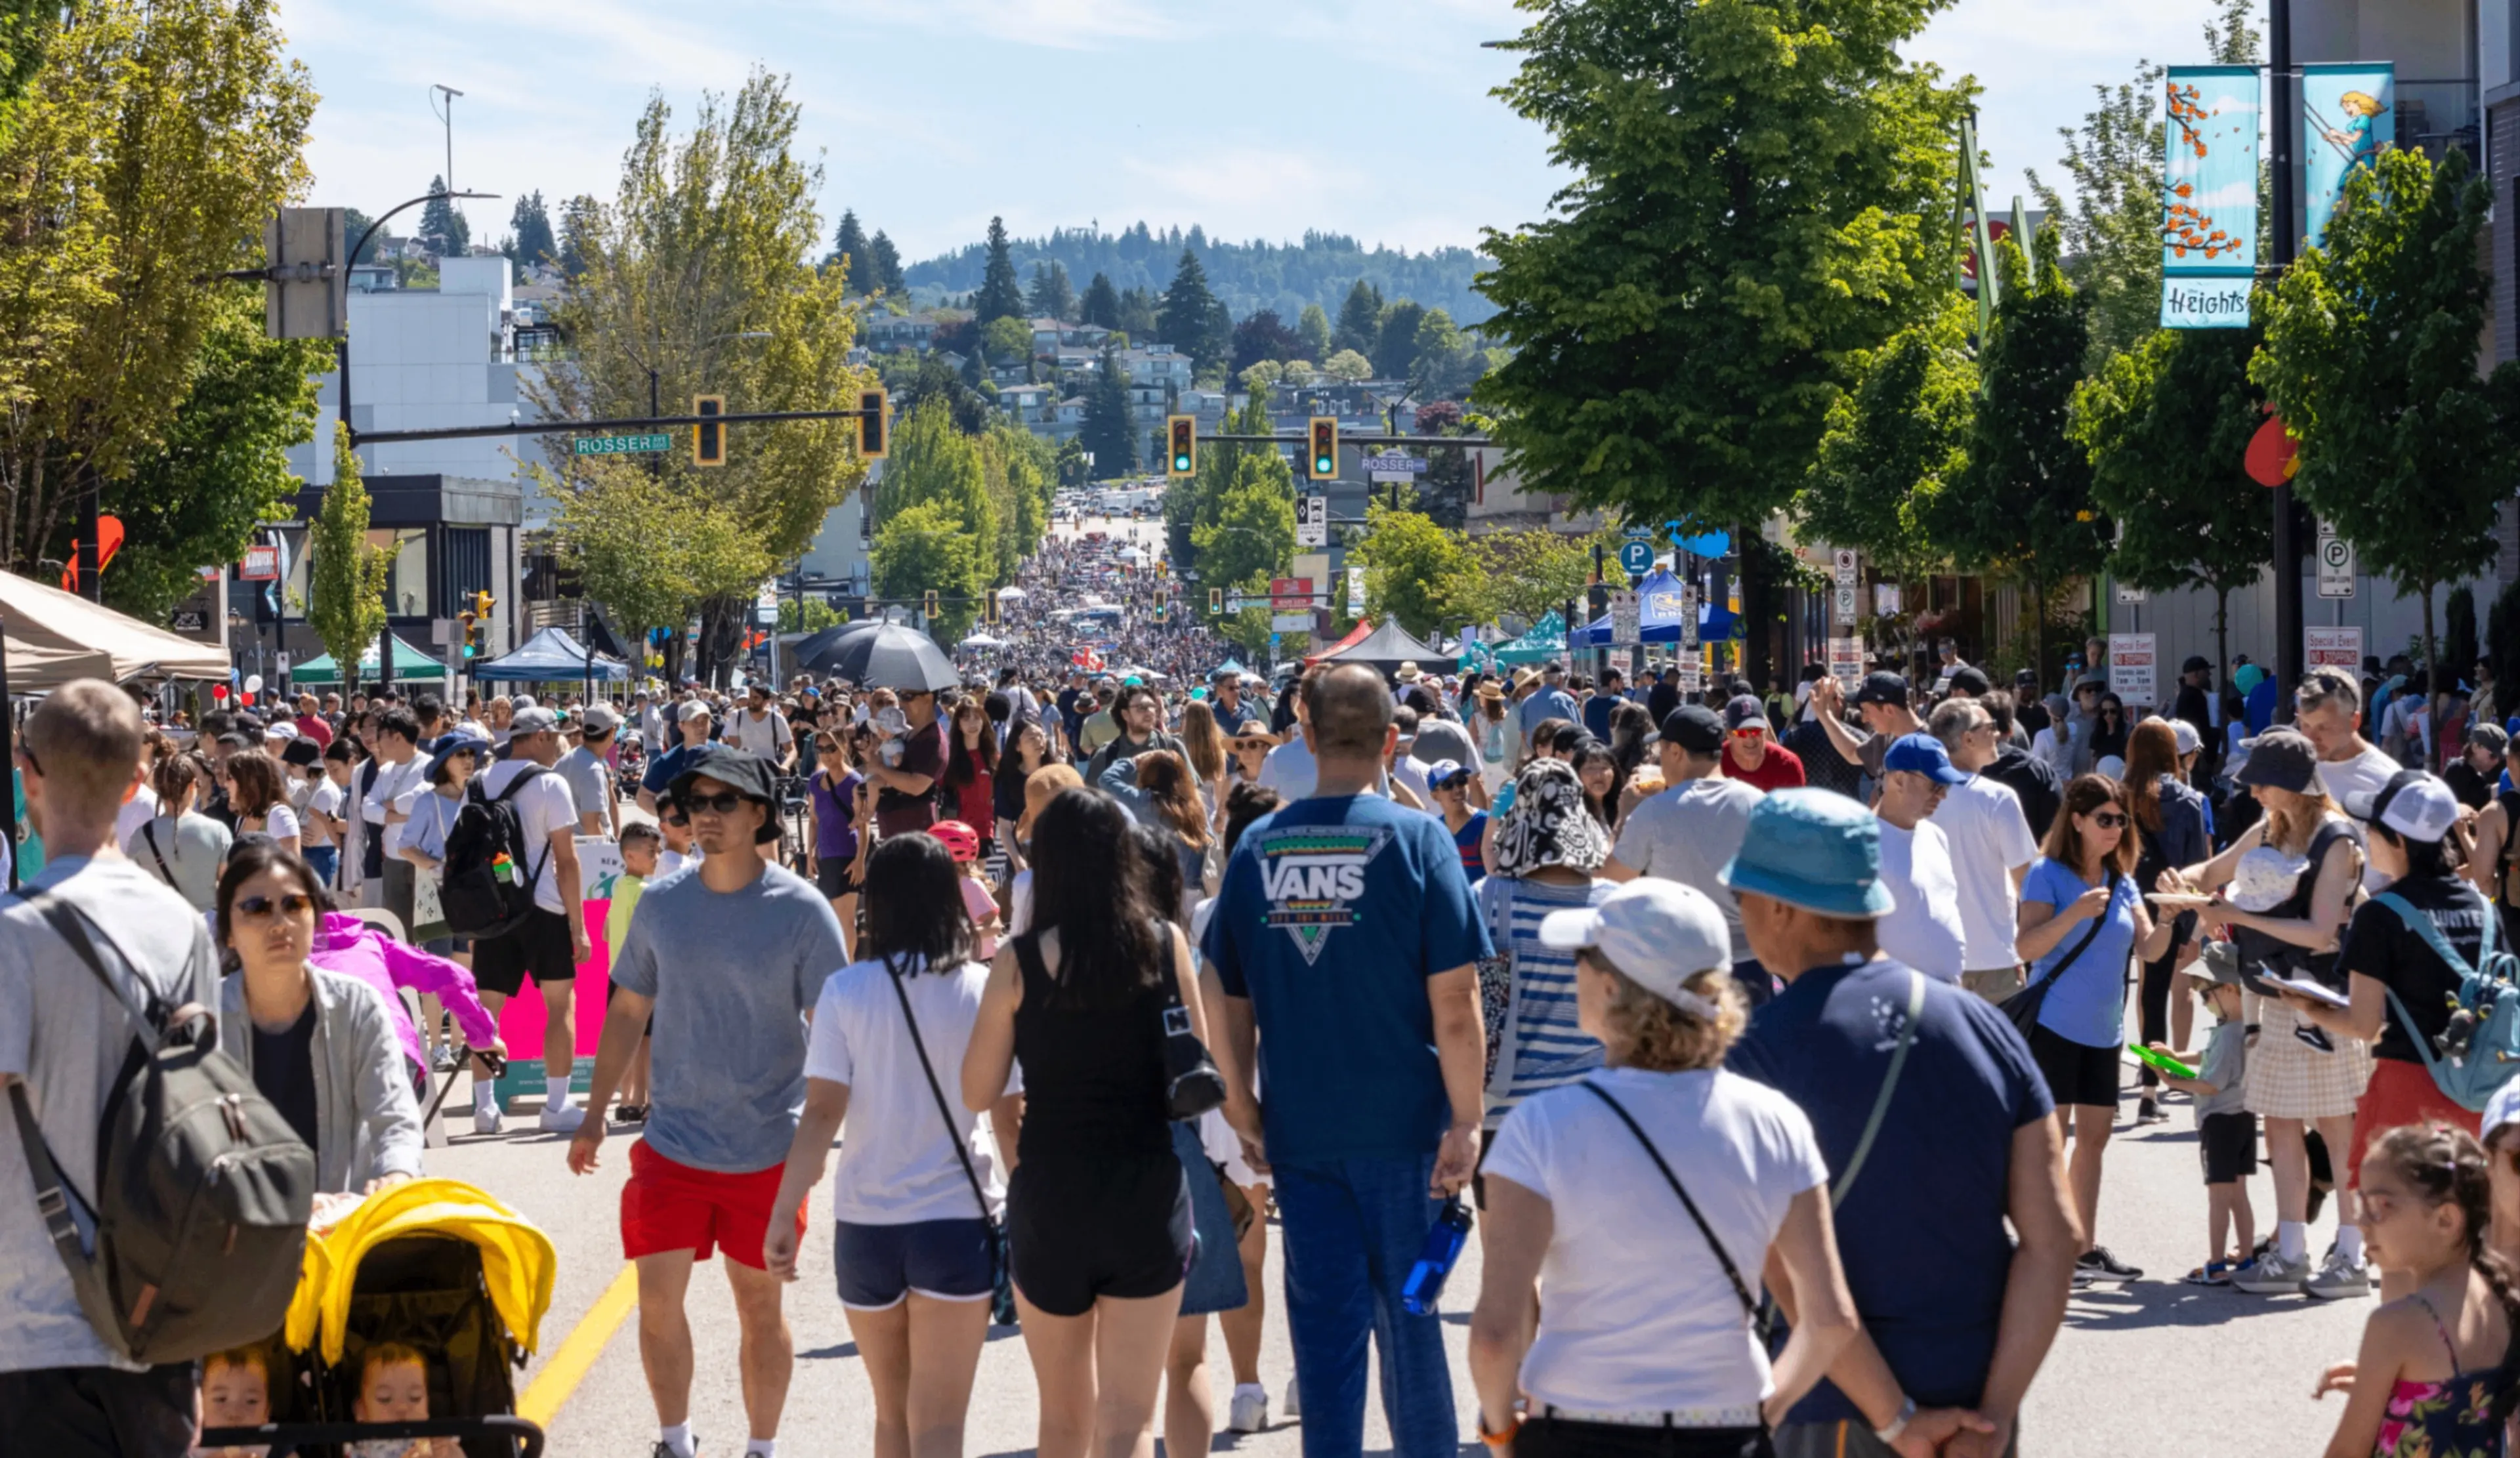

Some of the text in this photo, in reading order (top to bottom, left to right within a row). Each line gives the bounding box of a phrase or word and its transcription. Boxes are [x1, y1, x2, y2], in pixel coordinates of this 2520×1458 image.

[578, 437, 650, 452] ROSSER
[1362, 459, 1414, 470] ROSSER
[1631, 546, 1645, 563] P
[2332, 546, 2343, 561] P
[1842, 593, 1849, 604] P
[2113, 640, 2151, 651] Special Event
[2309, 634, 2357, 648] Special Event
[2114, 654, 2151, 665] NO STOPPING
[2310, 650, 2357, 665] NO STOPPING
[1260, 854, 1368, 901] VANS
